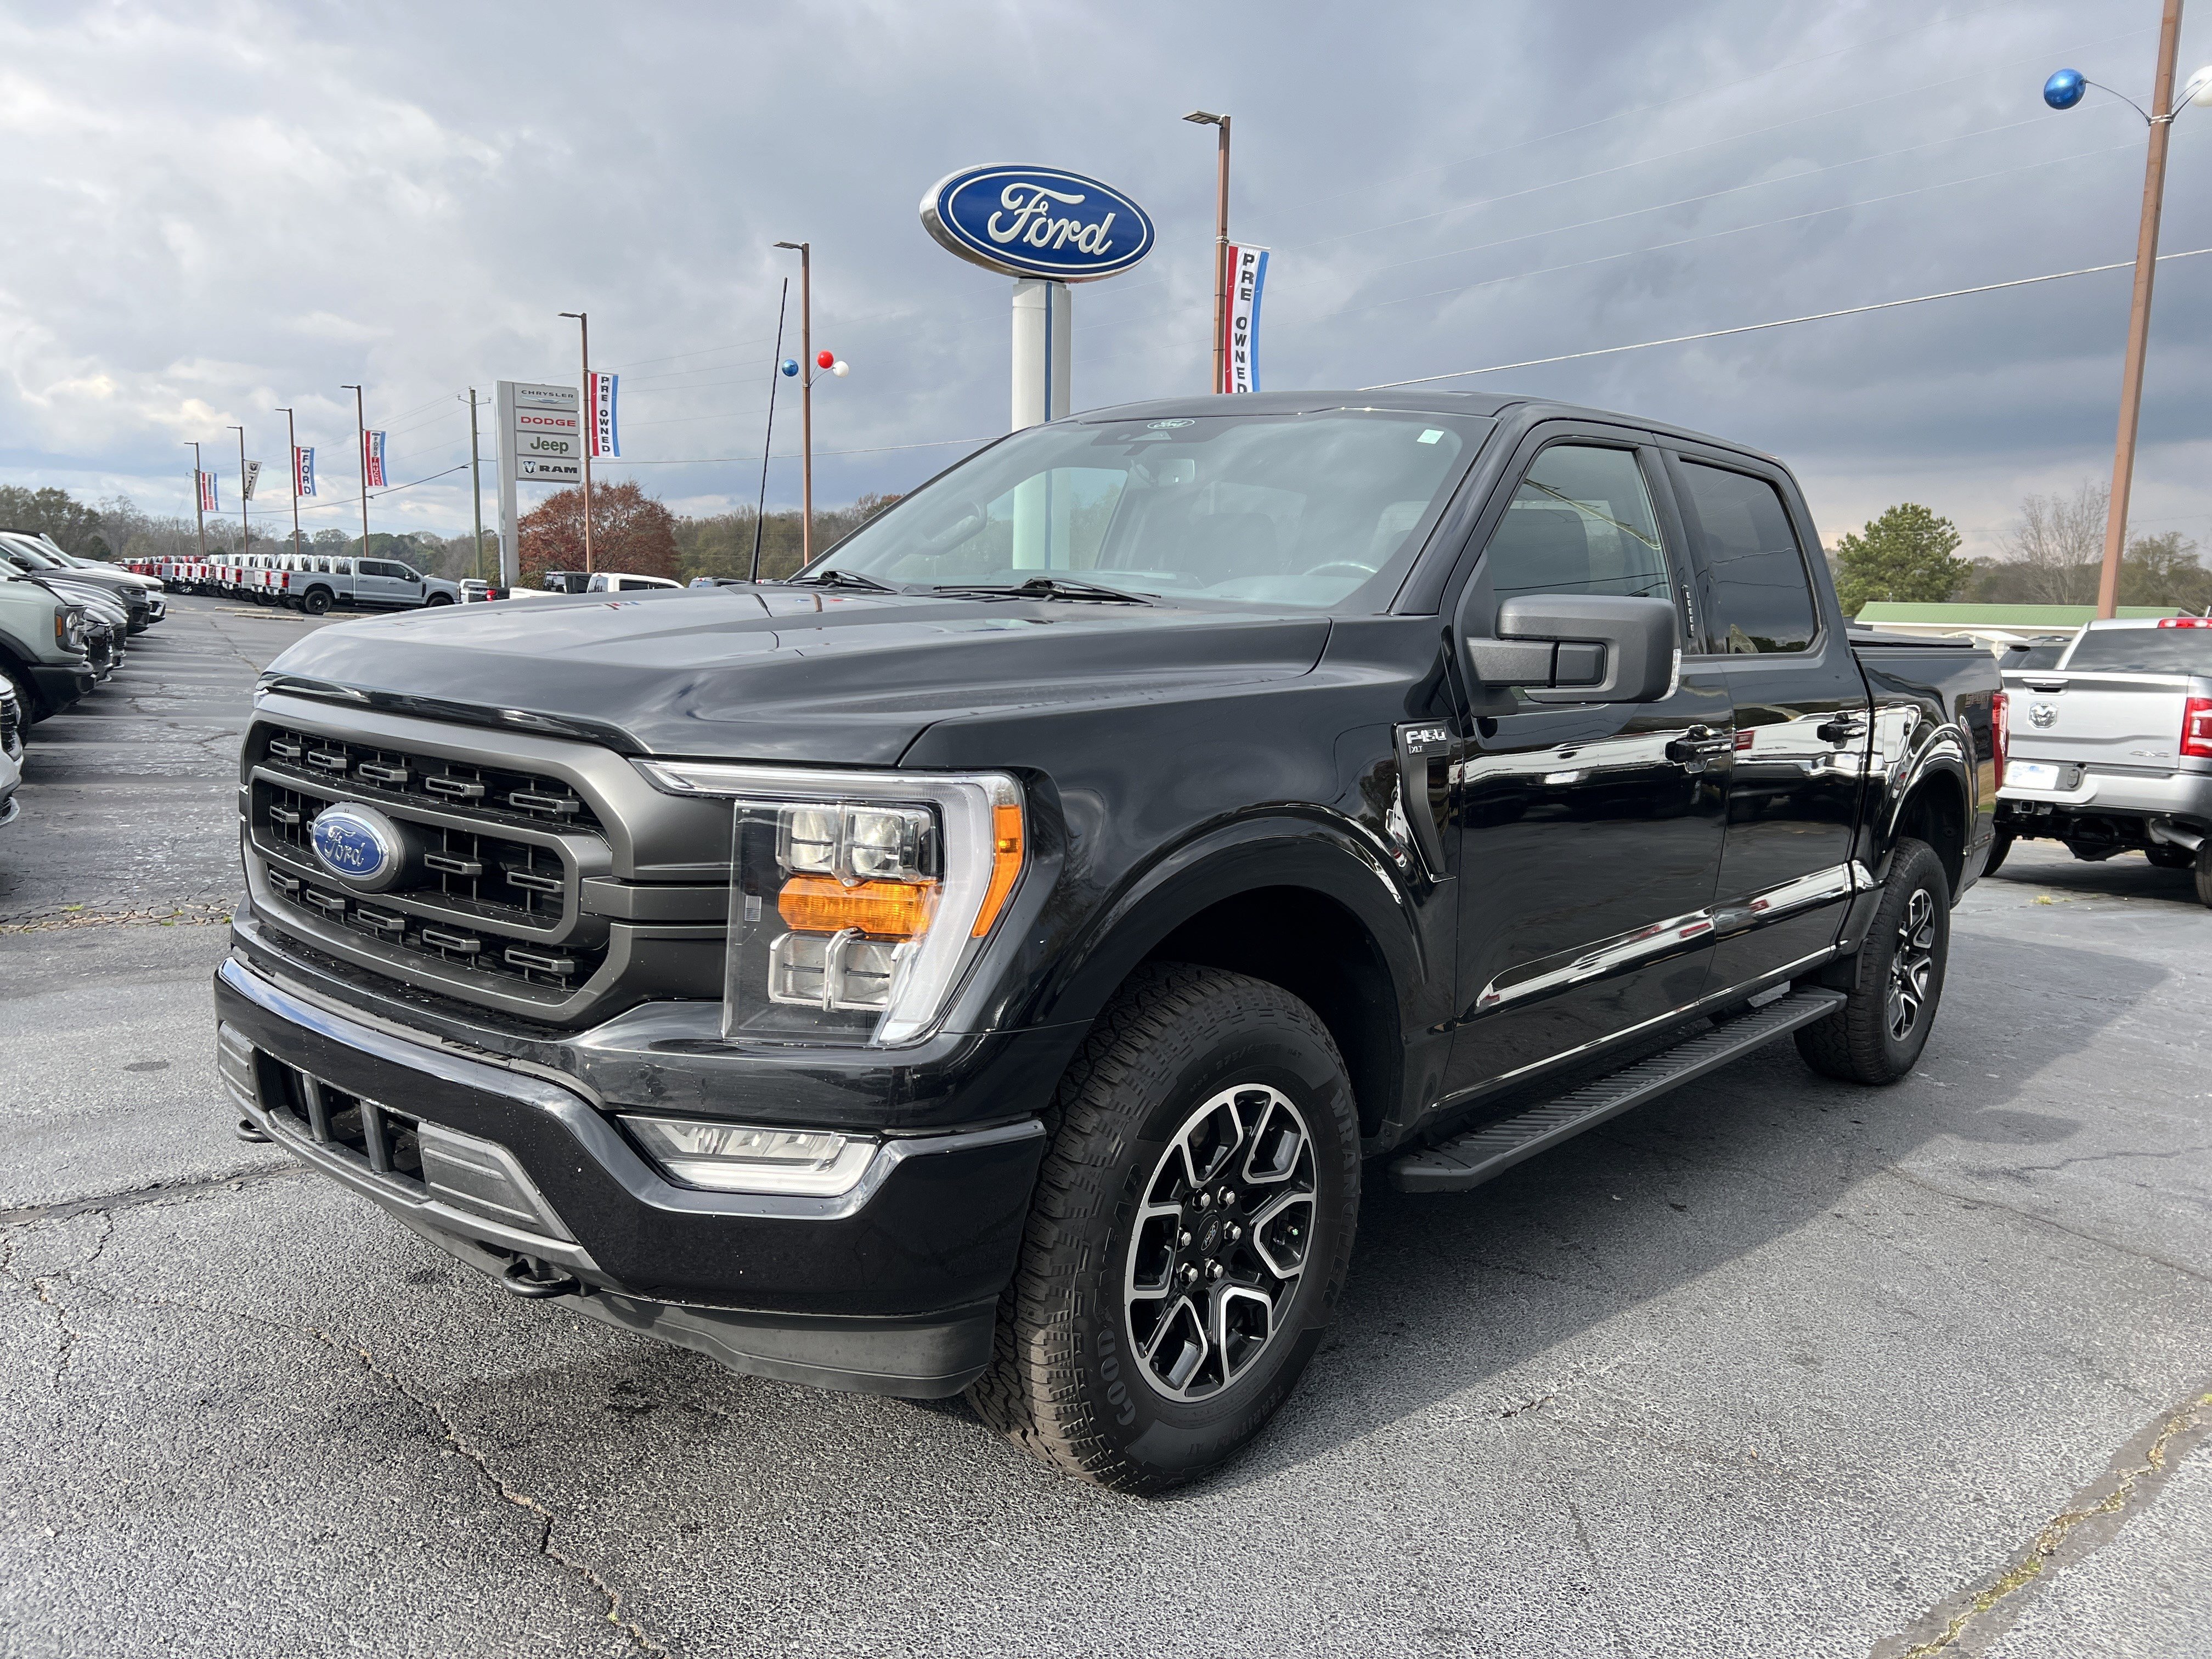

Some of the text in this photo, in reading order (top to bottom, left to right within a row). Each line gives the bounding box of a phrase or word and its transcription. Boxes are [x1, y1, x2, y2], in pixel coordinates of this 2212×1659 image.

[988, 182, 1116, 256] Ford
[1234, 252, 1255, 393] PRE OWNED
[521, 389, 574, 399] CHRYSLER
[521, 416, 576, 427] DODGE
[599, 376, 611, 453] PRE OWNED
[530, 437, 569, 454] Jeep
[302, 455, 312, 494] FORD
[539, 465, 578, 474] RAM
[1411, 745, 1423, 753] XLT
[324, 825, 366, 867] Ford
[1321, 1086, 1357, 1308] WRANGLER
[1093, 1163, 1144, 1426] GOODYEAR
